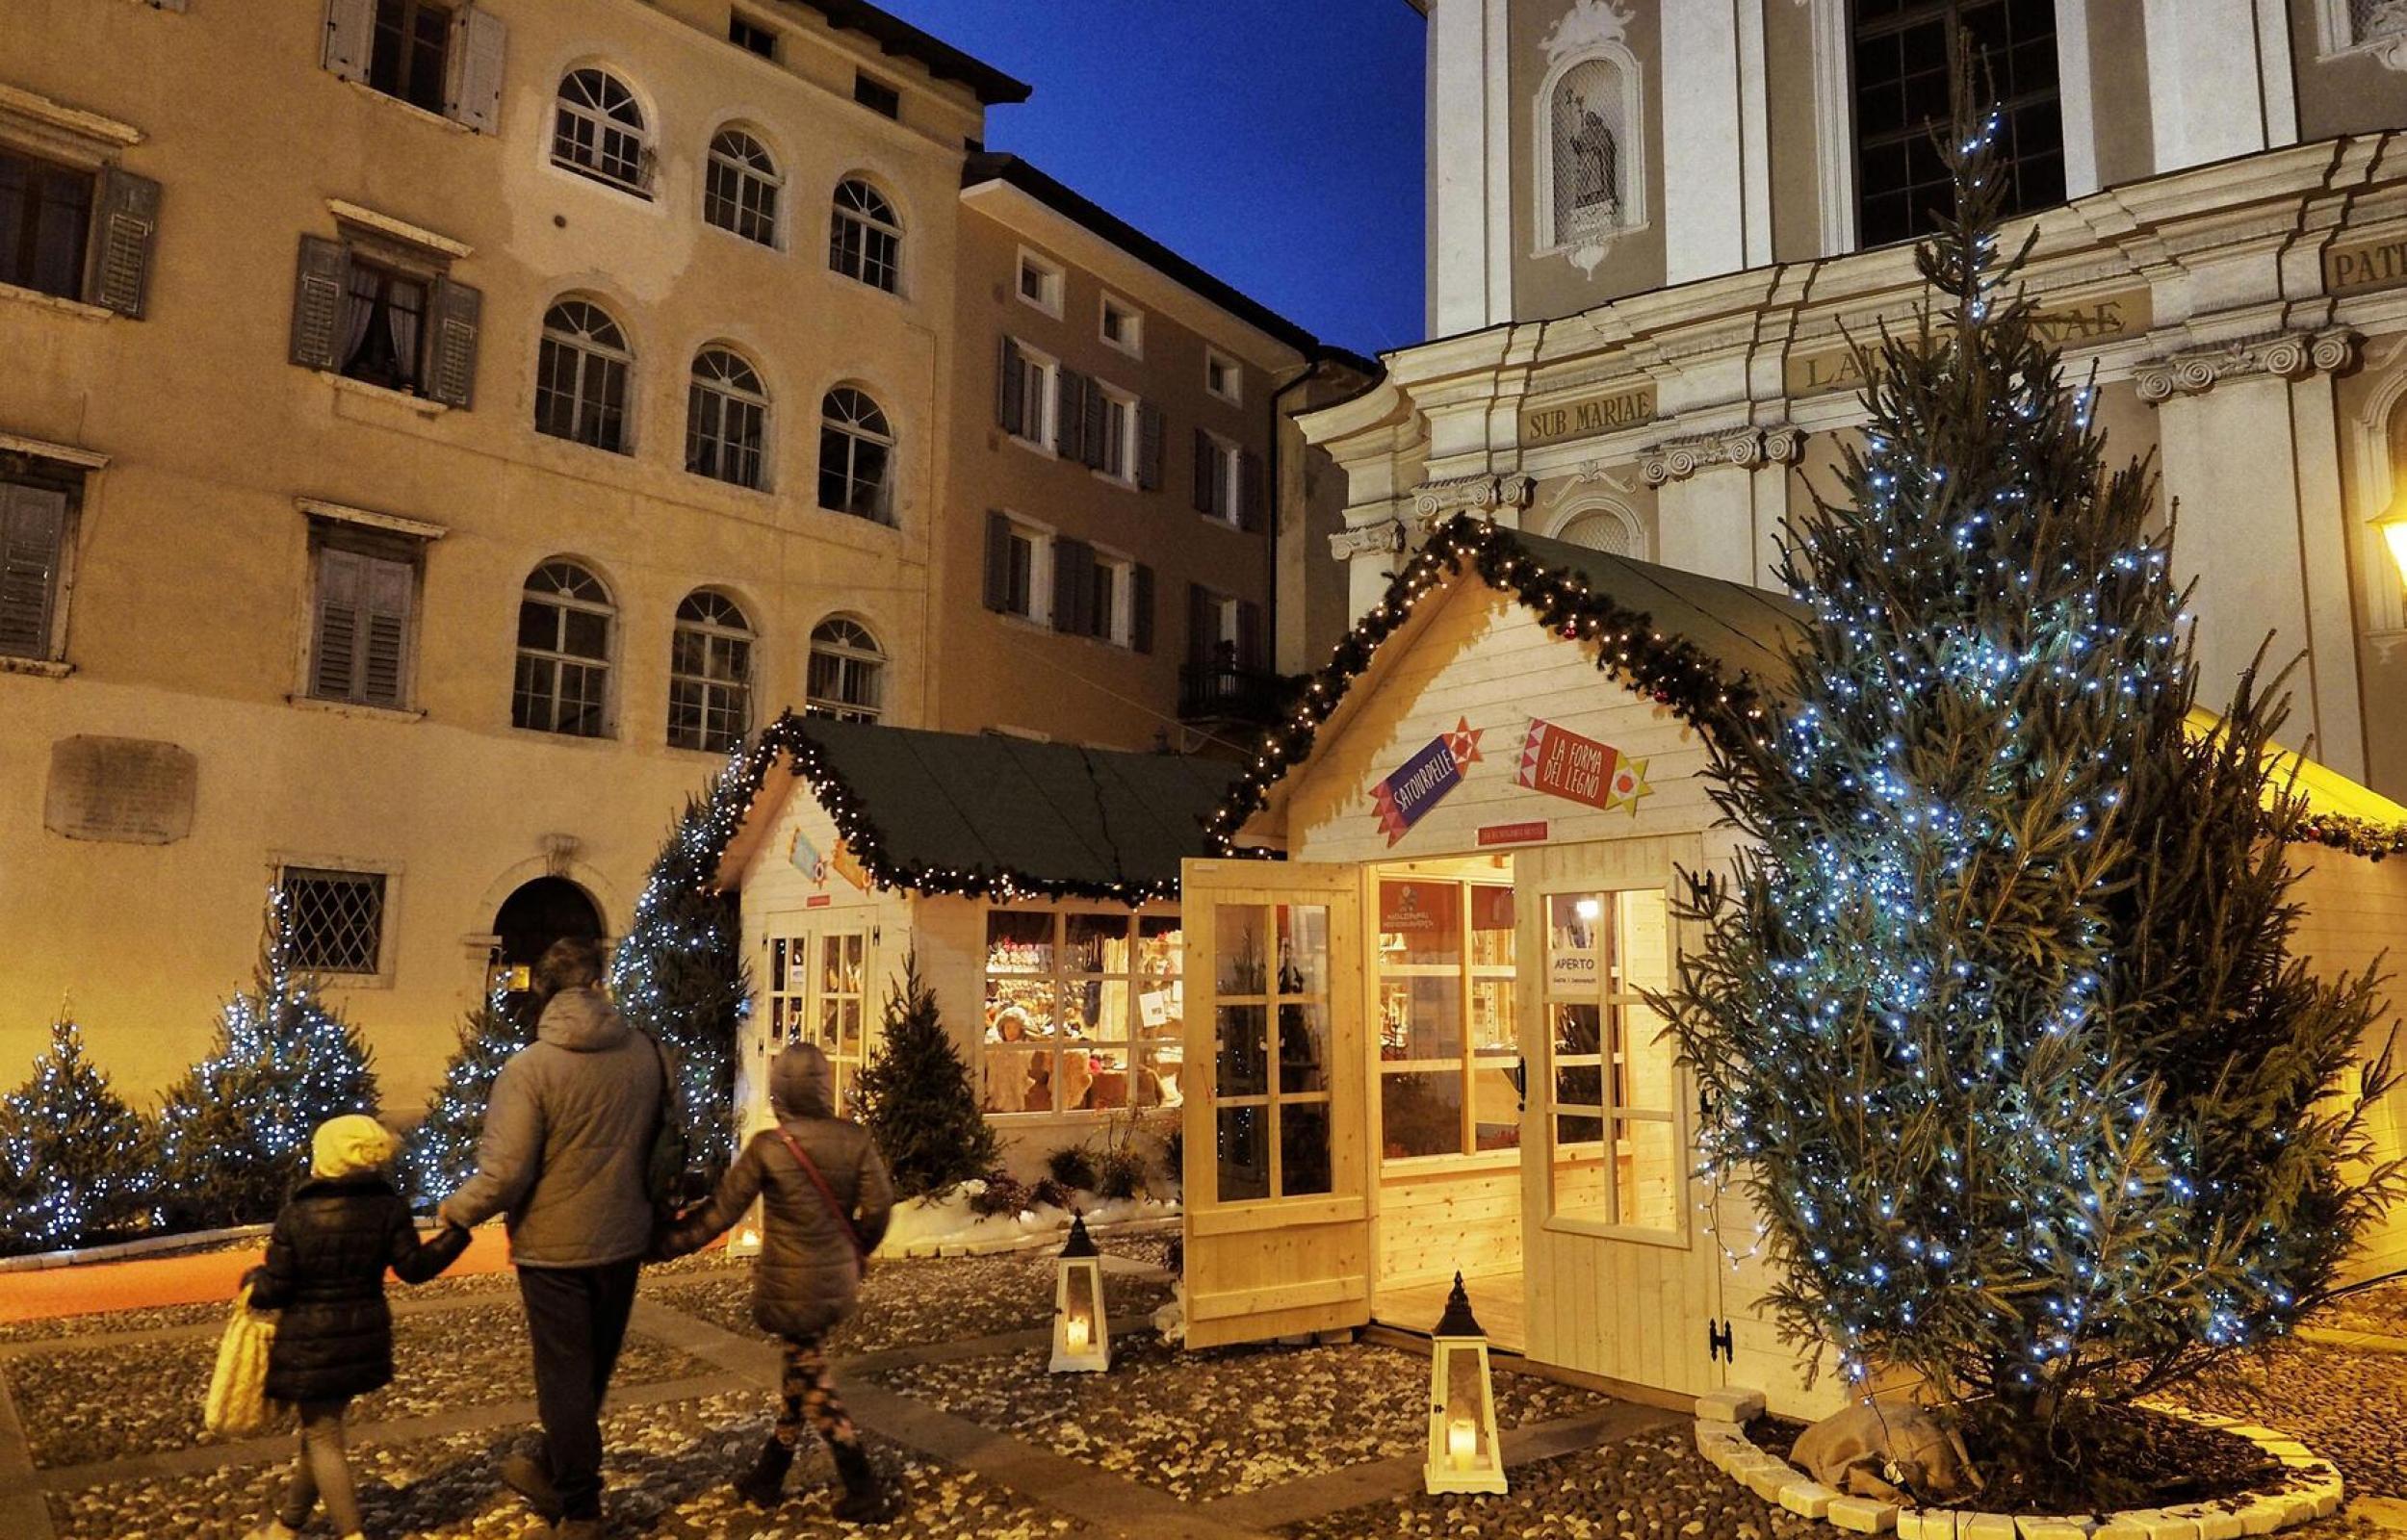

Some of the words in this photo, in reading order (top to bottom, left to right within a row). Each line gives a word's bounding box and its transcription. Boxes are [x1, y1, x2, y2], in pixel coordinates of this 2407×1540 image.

[1530, 409, 1566, 439] SUB
[1574, 392, 1650, 432] MARIAE
[1551, 736, 1566, 761] LA
[1568, 742, 1602, 774] FORMA
[1394, 749, 1455, 812] SATOURPELLE
[1543, 758, 1562, 787] DEL
[1564, 765, 1599, 799] LEGNO
[1554, 958, 1594, 970] APERTO
